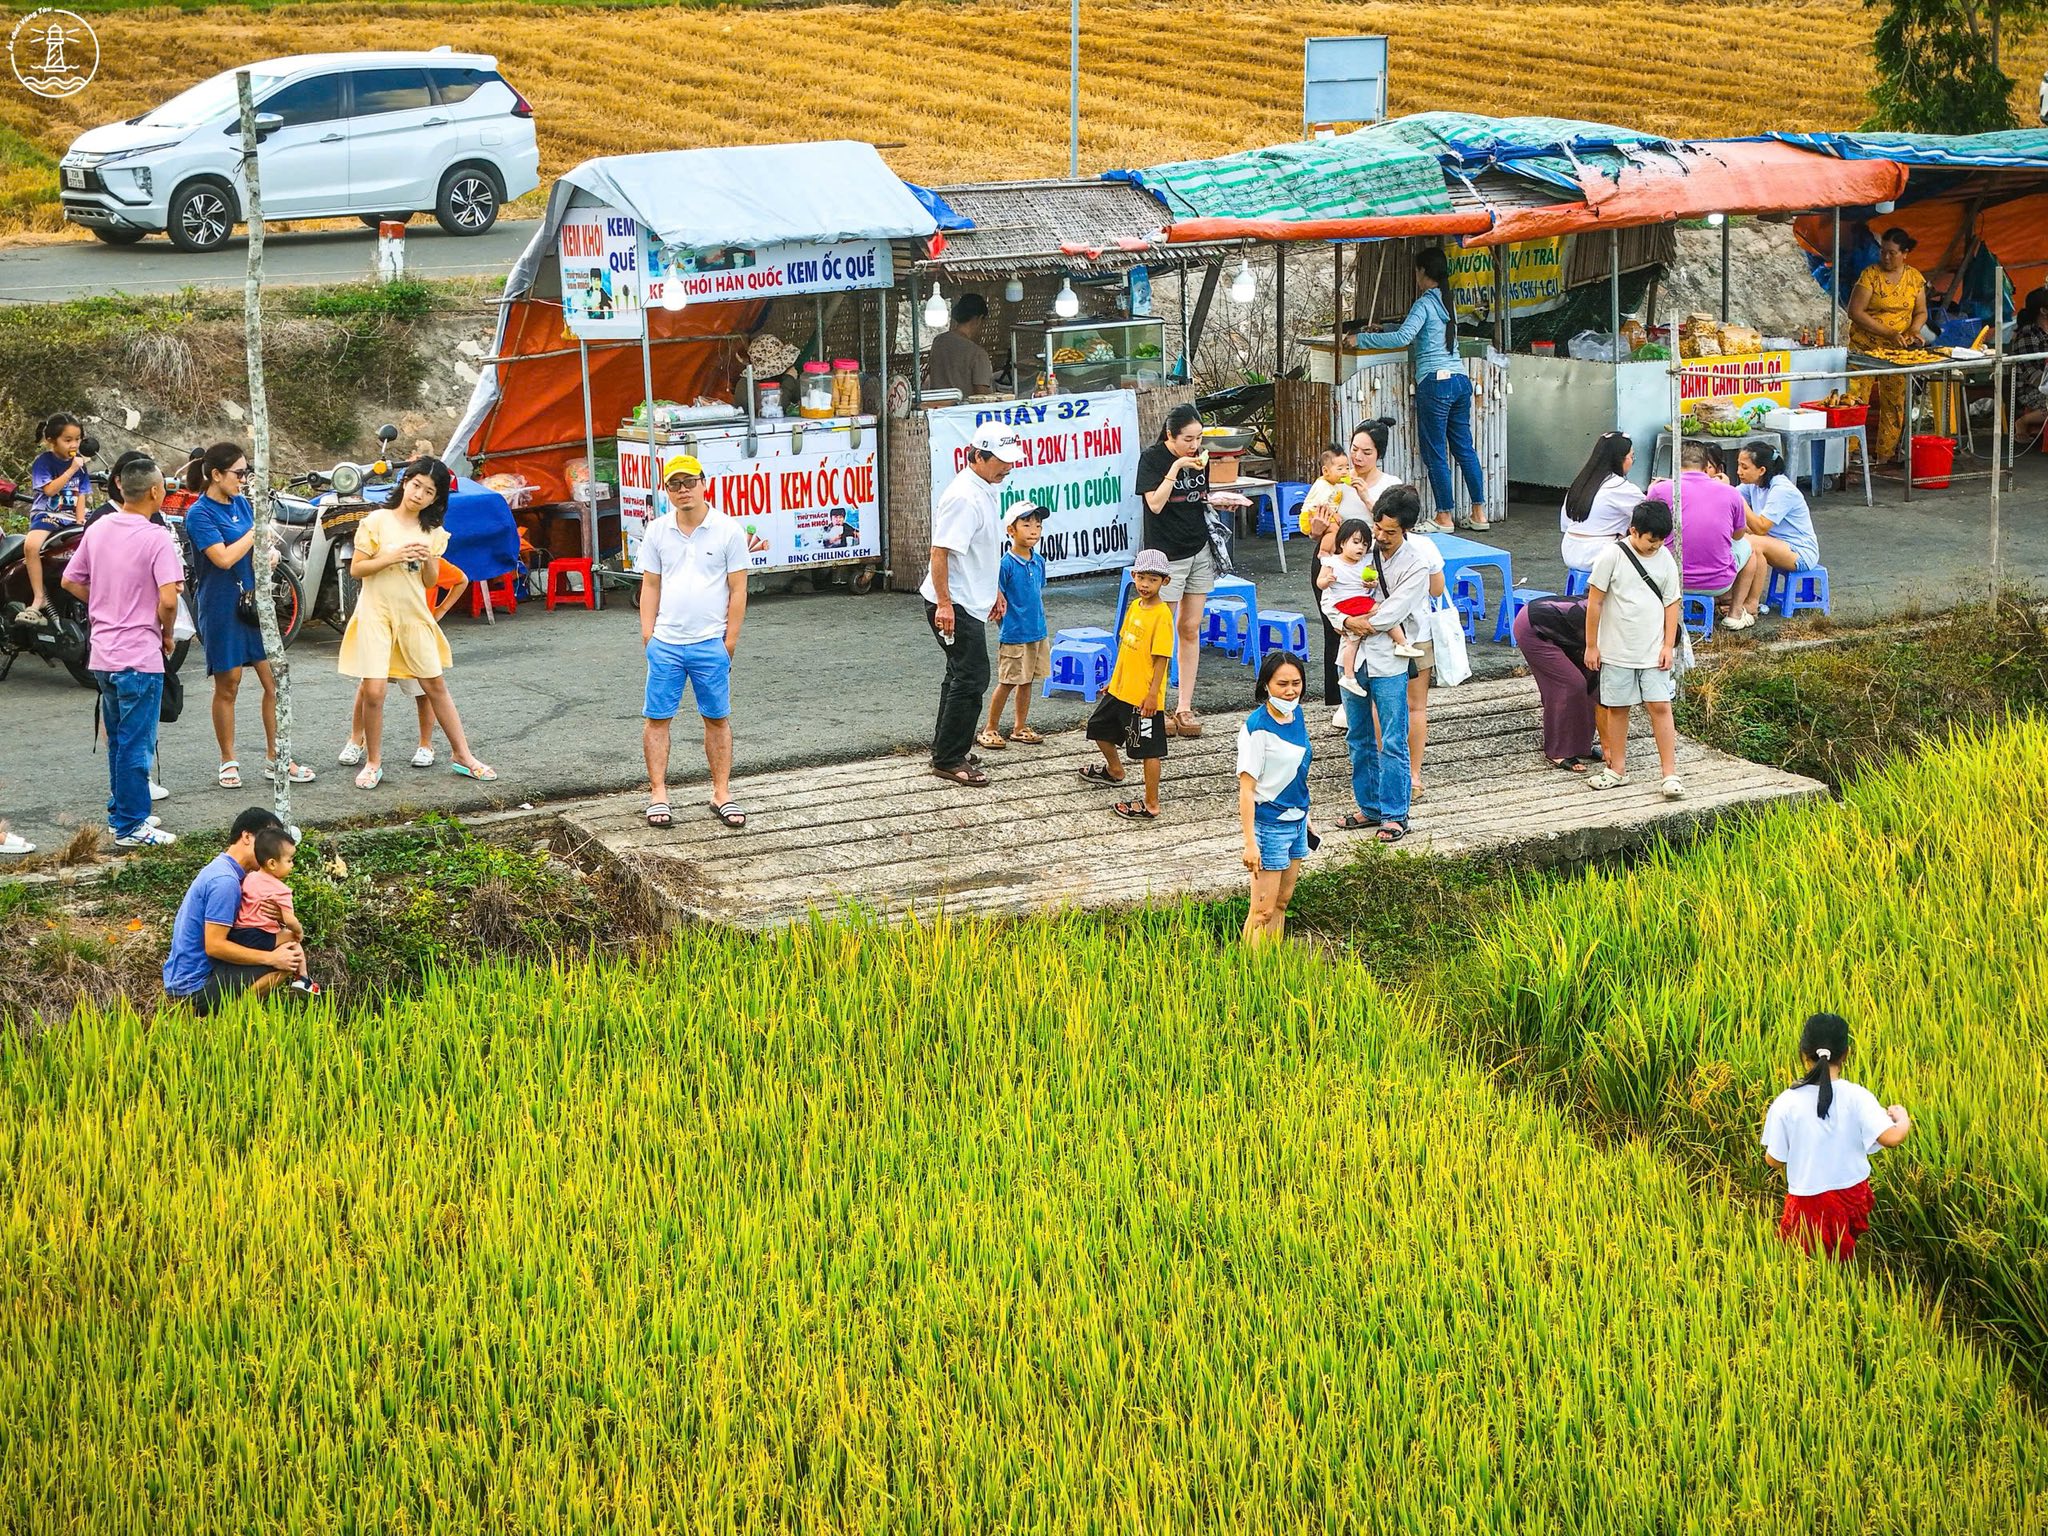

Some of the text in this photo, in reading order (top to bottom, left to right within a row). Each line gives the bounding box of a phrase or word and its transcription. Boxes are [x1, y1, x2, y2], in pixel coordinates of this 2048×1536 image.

[562, 215, 604, 256] KEM KHÓI
[607, 217, 635, 236] KEM
[609, 245, 636, 273] QUẾ
[1534, 243, 1559, 265] TRÁI
[649, 283, 664, 299] KE
[716, 271, 744, 293] HÀN
[748, 265, 783, 290] QUỐC
[787, 260, 818, 284] KEM
[822, 251, 841, 281] ỐC
[846, 247, 876, 280] QUẾ
[1680, 362, 1709, 398] BÁNH
[1712, 363, 1740, 396] CANH
[1057, 399, 1090, 420] 32
[1037, 433, 1067, 465] 20K/
[1071, 433, 1078, 459] 1
[1083, 417, 1122, 459] PHẦN
[621, 453, 639, 488] KEM
[722, 463, 771, 517] KHÓI
[780, 471, 813, 510] KEM
[817, 456, 839, 507] ỐC
[843, 452, 875, 509] QUẾ
[1063, 481, 1080, 510] 10
[1084, 466, 1121, 507] CUỐN
[1073, 529, 1089, 557] 10
[1093, 515, 1128, 555] CUỐN
[788, 548, 871, 563] BING CHILLING KEM
